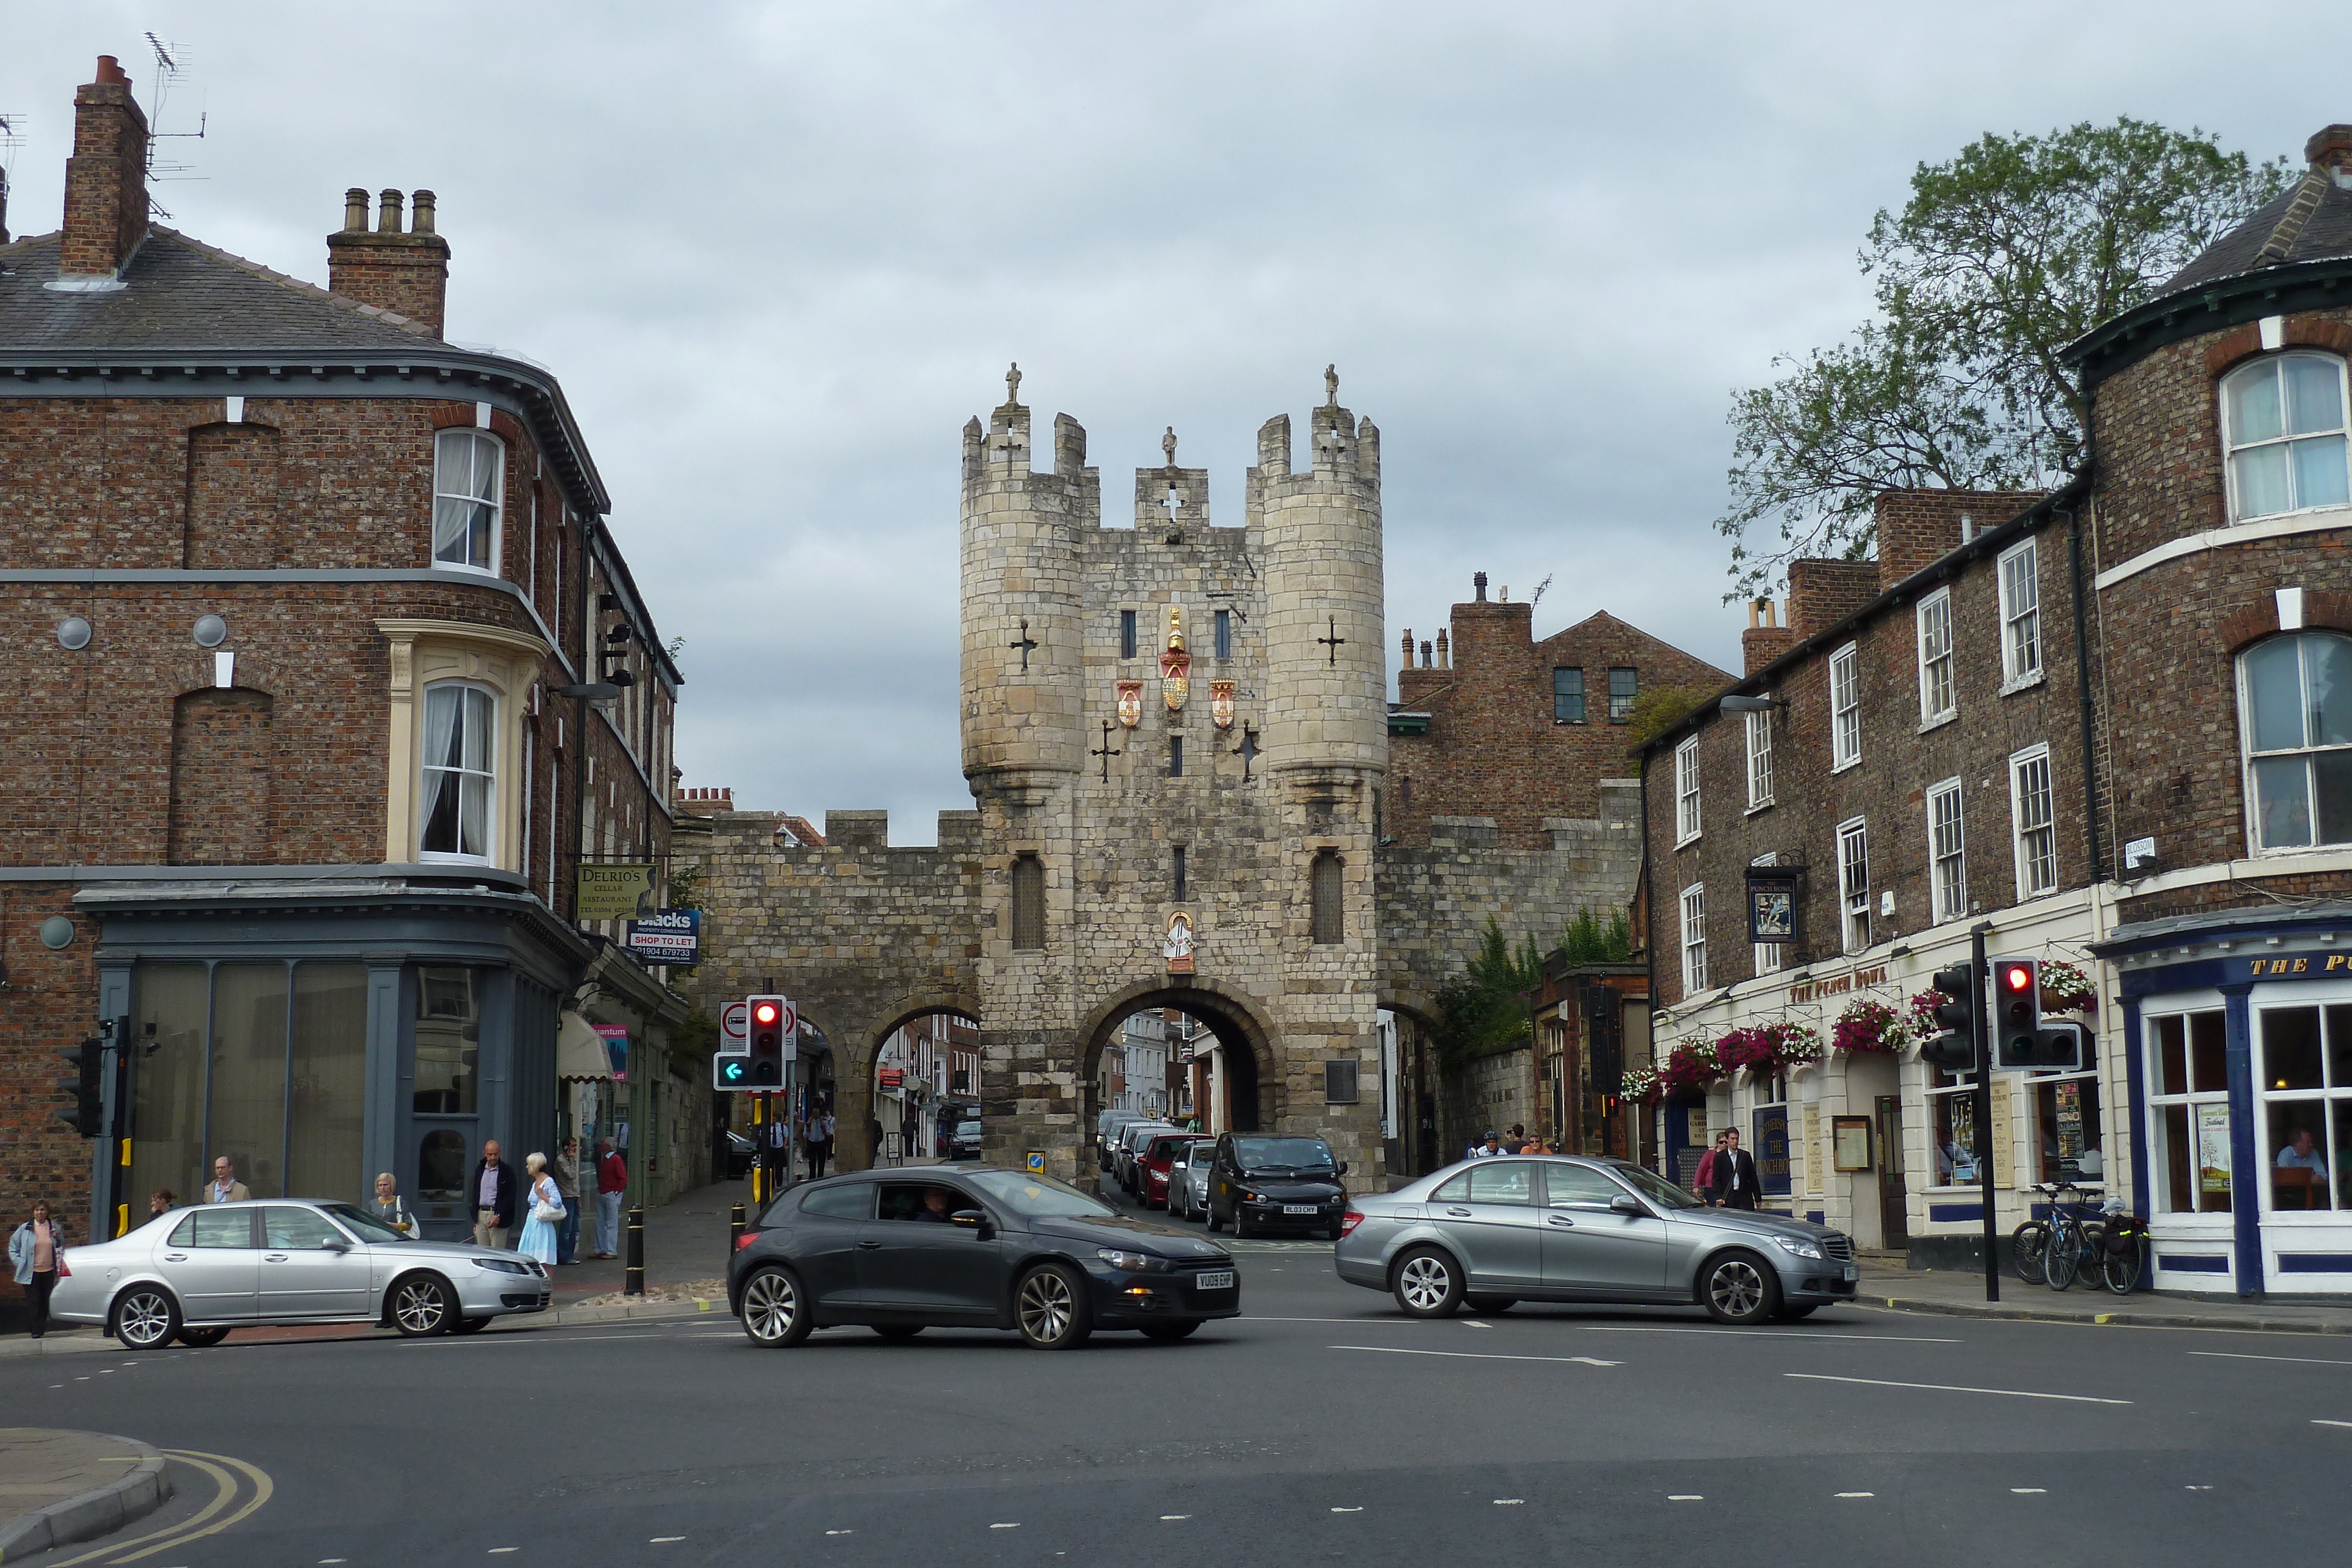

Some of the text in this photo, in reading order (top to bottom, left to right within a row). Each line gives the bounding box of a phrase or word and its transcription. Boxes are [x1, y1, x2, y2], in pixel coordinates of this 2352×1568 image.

[2127, 838, 2153, 854] BLOSSOM
[582, 869, 640, 882] DELRIO'S
[635, 936, 659, 944] SHOP
[662, 948, 690, 957] 679733
[2250, 958, 2308, 975] THE
[1790, 966, 1887, 1003] THE PUNCH BOWL
[2205, 1117, 2225, 1126] Festival
[1769, 1140, 1783, 1154] THE
